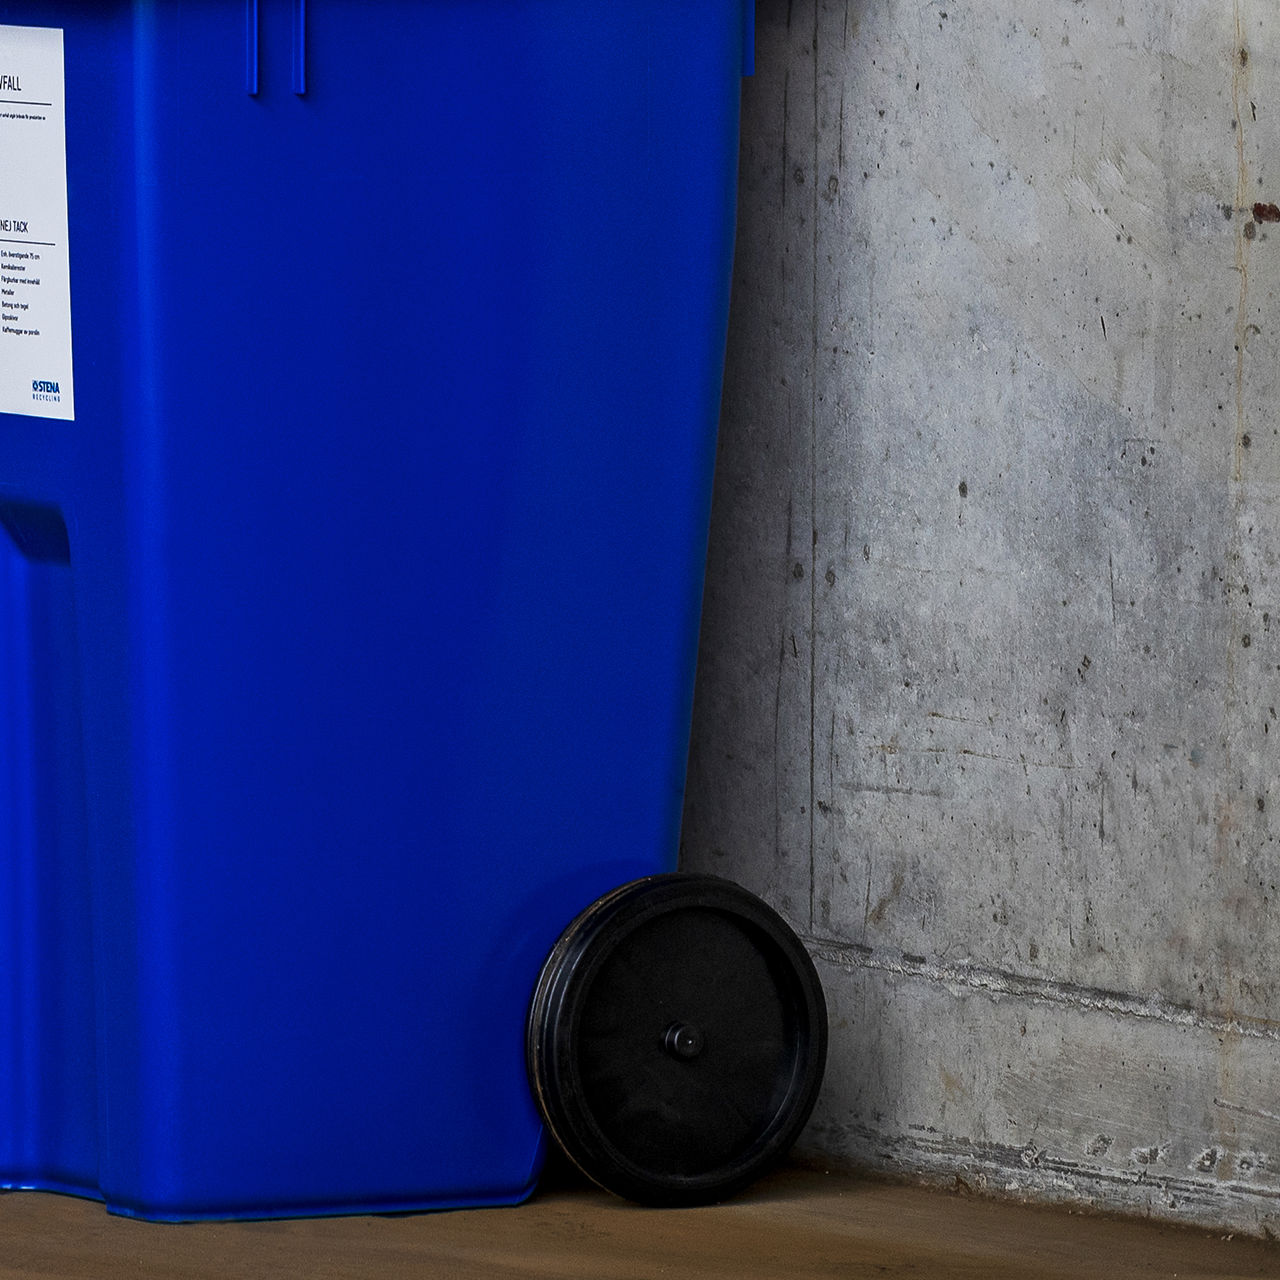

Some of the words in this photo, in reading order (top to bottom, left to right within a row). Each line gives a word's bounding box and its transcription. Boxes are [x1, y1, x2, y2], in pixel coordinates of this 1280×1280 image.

[0, 220, 11, 232] NEJ
[13, 221, 28, 233] TACK
[39, 381, 60, 394] STENA
[32, 394, 61, 402] RECYCLING
